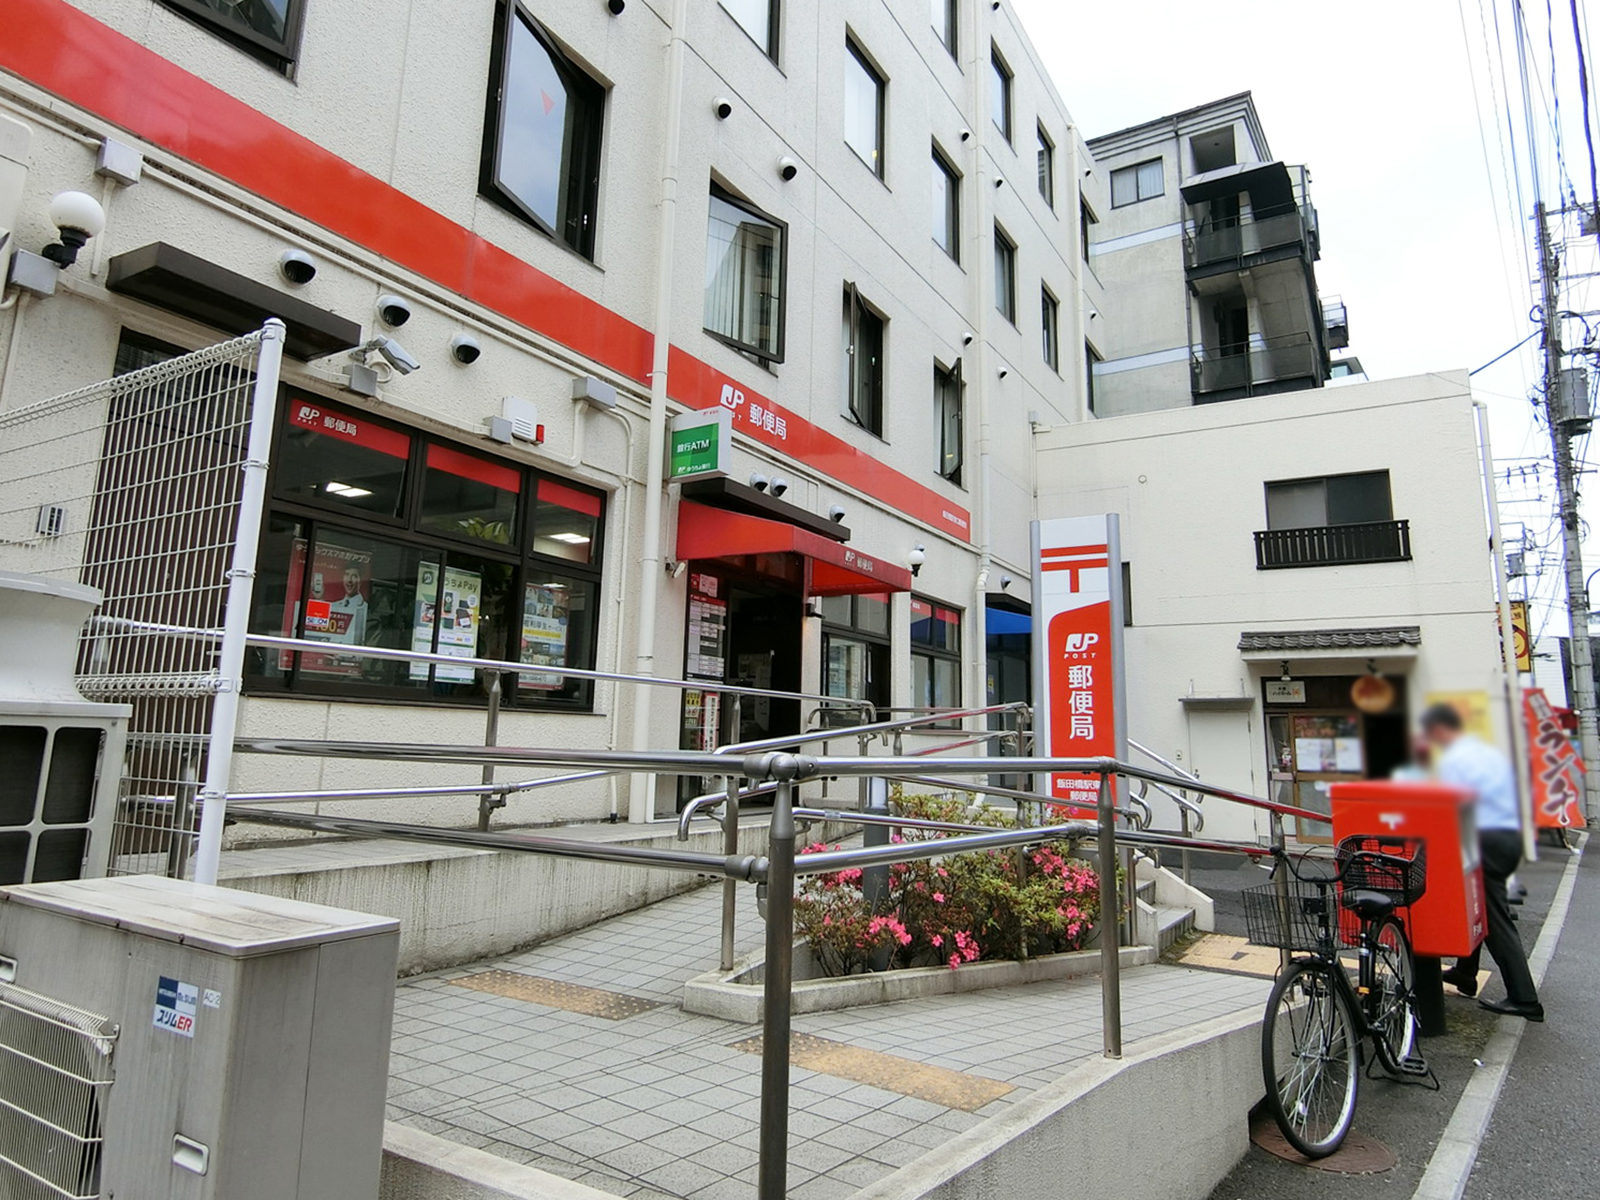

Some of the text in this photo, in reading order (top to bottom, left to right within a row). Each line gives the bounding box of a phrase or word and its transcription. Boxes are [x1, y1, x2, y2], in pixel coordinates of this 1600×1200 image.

[720, 384, 787, 441] JP 郵便局
[324, 416, 357, 436] 郵便局
[1065, 633, 1099, 652] JP
[1063, 652, 1096, 660] POST
[1068, 665, 1094, 740] 郵便局
[1056, 778, 1101, 790] 飯田橋駅東
[157, 1009, 192, 1032] スリムER
